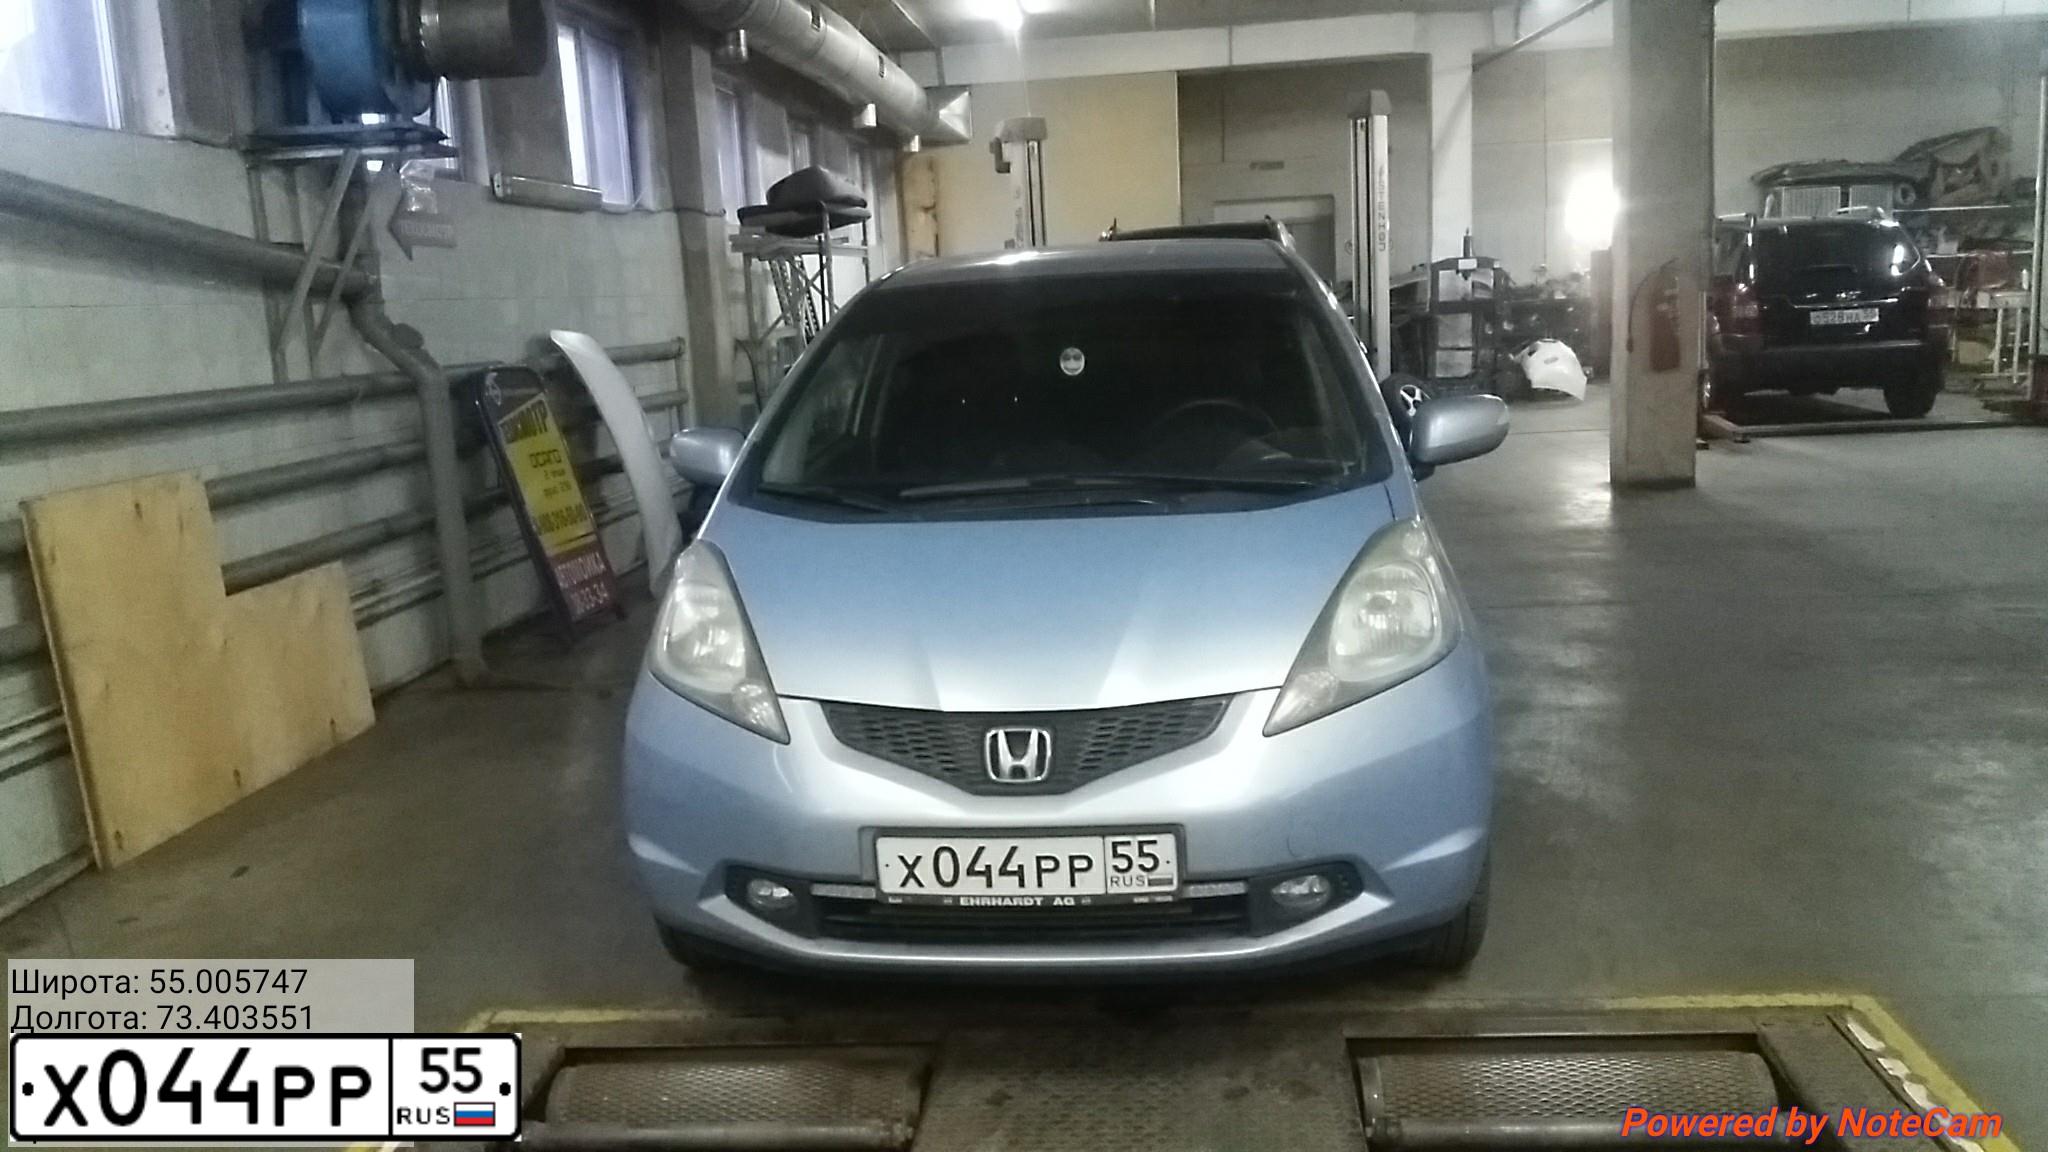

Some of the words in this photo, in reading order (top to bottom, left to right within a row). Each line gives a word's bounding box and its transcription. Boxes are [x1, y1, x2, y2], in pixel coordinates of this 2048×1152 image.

[898, 846, 1094, 888] Х044РР
[1111, 840, 1159, 874] 55
[1111, 874, 1145, 887] RUS
[960, 897, 1043, 905] EHRHARDT
[1053, 897, 1075, 905] AG
